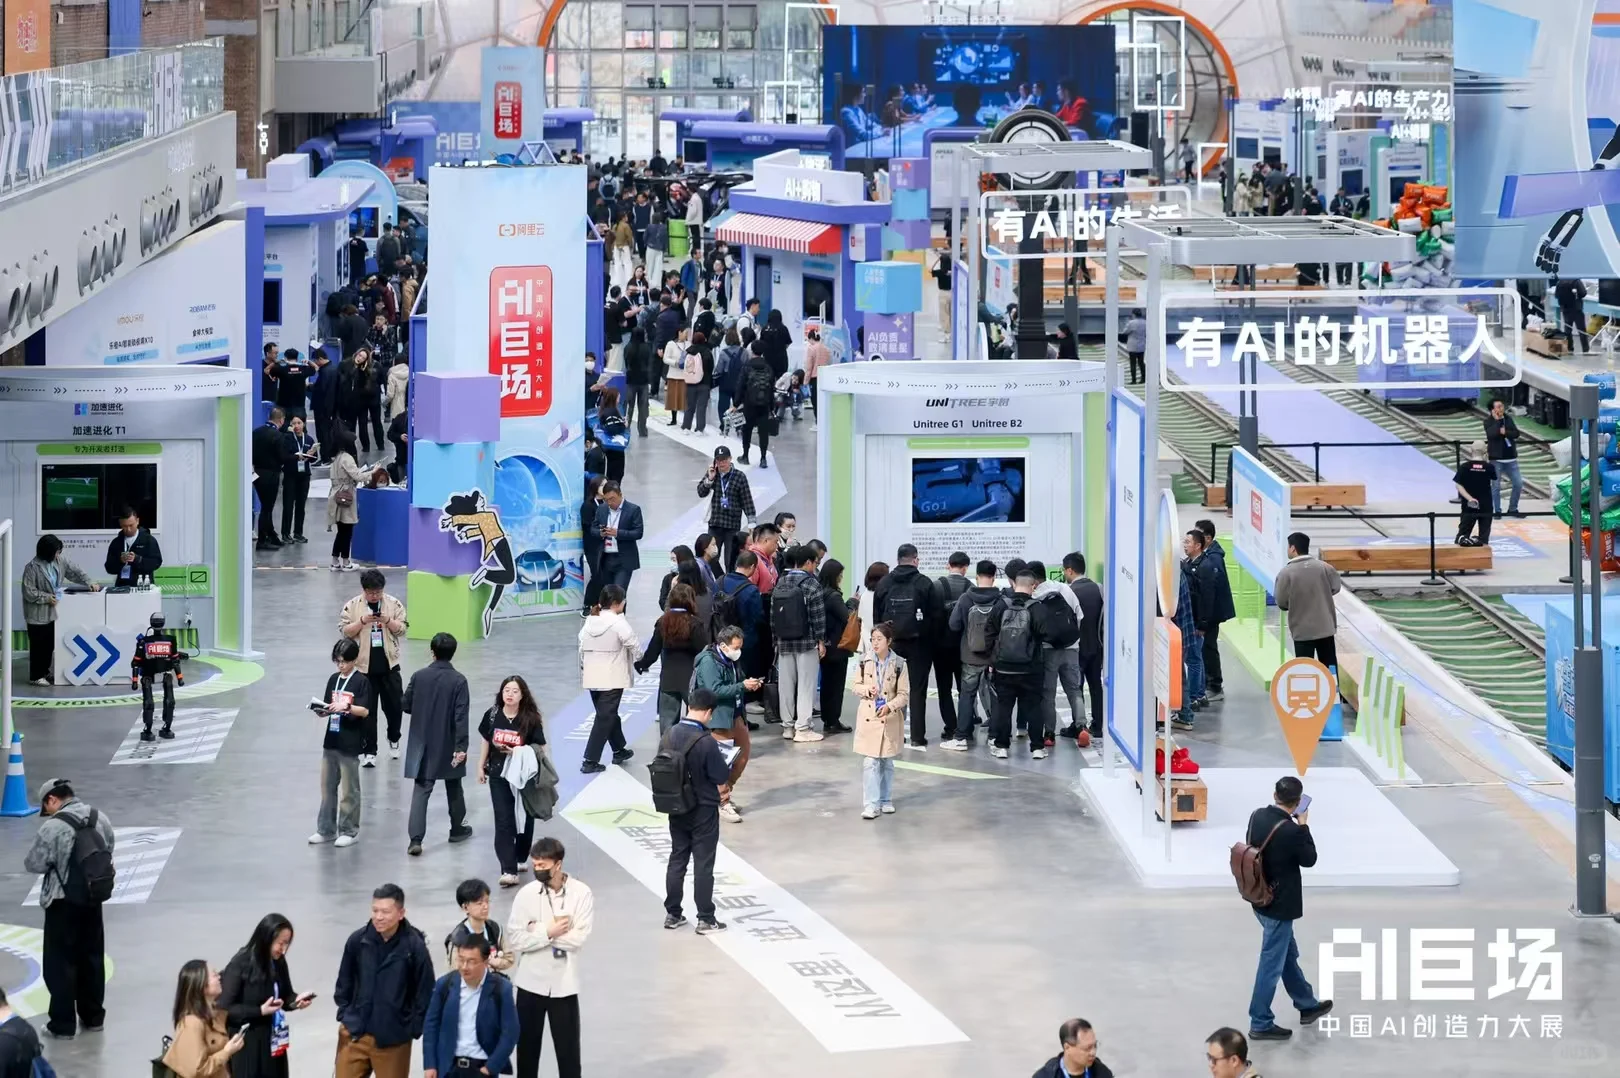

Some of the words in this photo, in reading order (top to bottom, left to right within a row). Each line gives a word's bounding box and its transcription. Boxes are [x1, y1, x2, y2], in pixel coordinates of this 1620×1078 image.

[1335, 89, 1449, 108] 有AI的生产力
[436, 132, 480, 150] AI巨
[517, 223, 545, 236] 阿里云
[499, 279, 533, 400] AI巨场
[1175, 315, 1508, 368] 有AI的机器人
[91, 403, 124, 411] 加速进化
[73, 426, 113, 436] 加速进化
[115, 426, 126, 434] T1
[913, 420, 949, 428] Unitree
[951, 420, 964, 428] G1
[972, 419, 1008, 428] Unitree
[1010, 419, 1022, 428] B2
